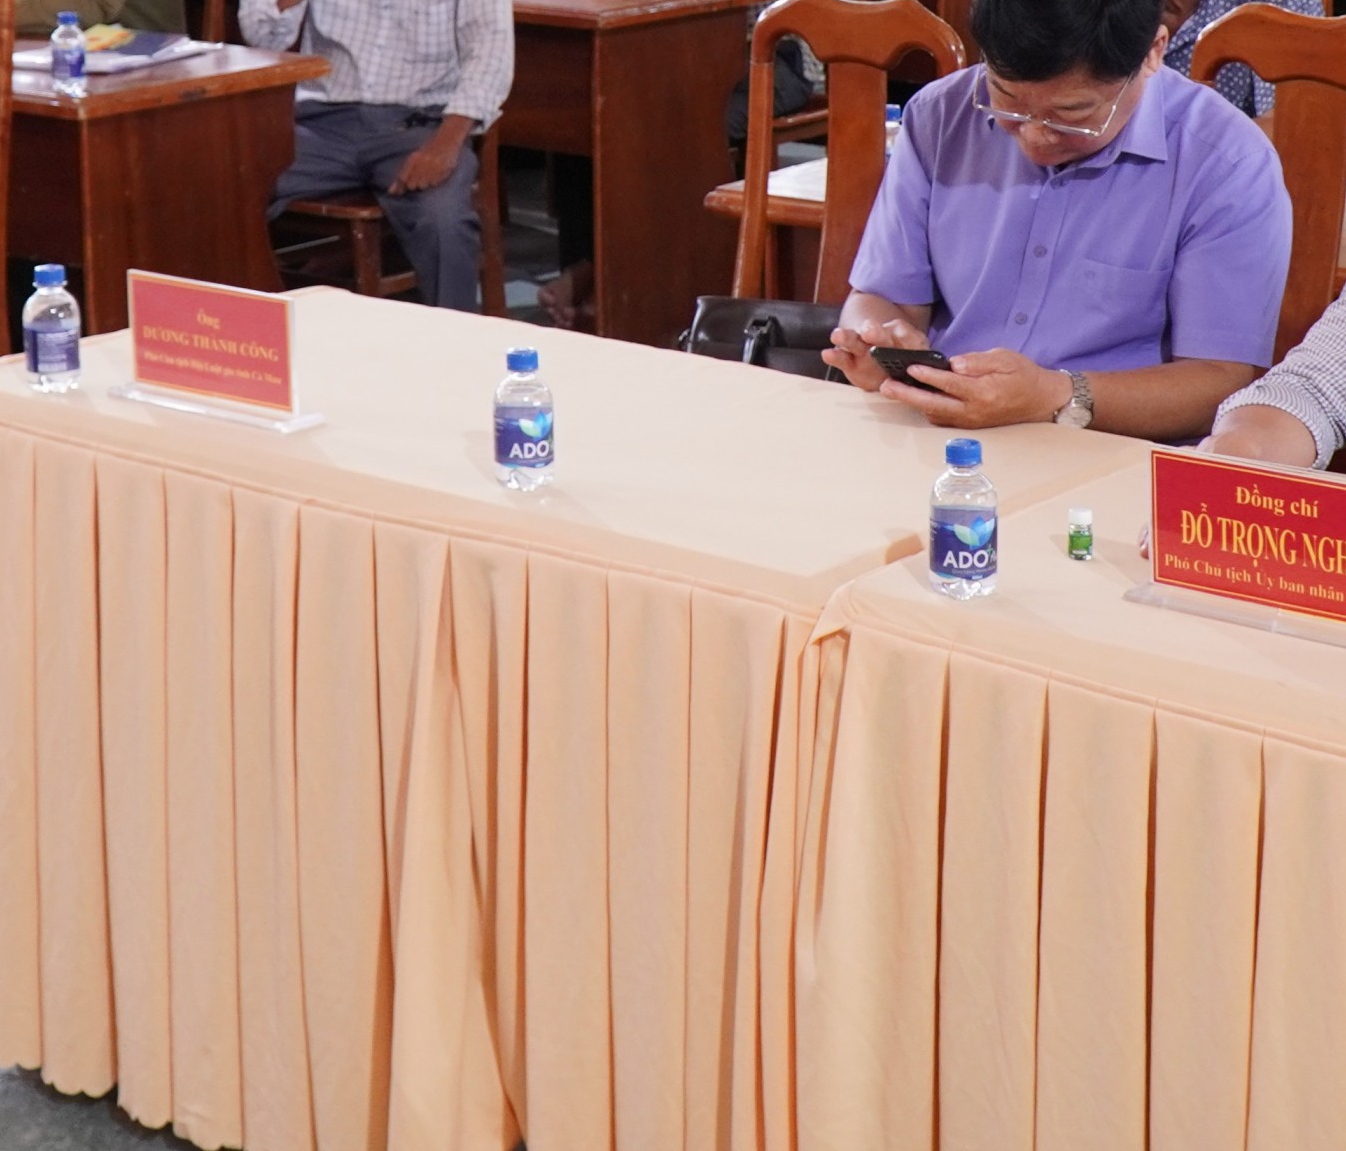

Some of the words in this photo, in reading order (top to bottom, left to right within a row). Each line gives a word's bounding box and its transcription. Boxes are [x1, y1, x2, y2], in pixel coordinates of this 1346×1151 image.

[509, 440, 550, 459] ADO
[1235, 484, 1285, 517] Đồng
[1290, 498, 1319, 518] chí
[1180, 502, 1213, 548] ĐỖ
[1217, 516, 1298, 567] TRỌNG
[942, 550, 989, 569] ADO
[1164, 553, 1190, 571] Phó
[1193, 558, 1222, 578] Chủ
[1226, 564, 1252, 585] tịch
[1279, 576, 1305, 595] ban
[1309, 584, 1345, 603] nhân
